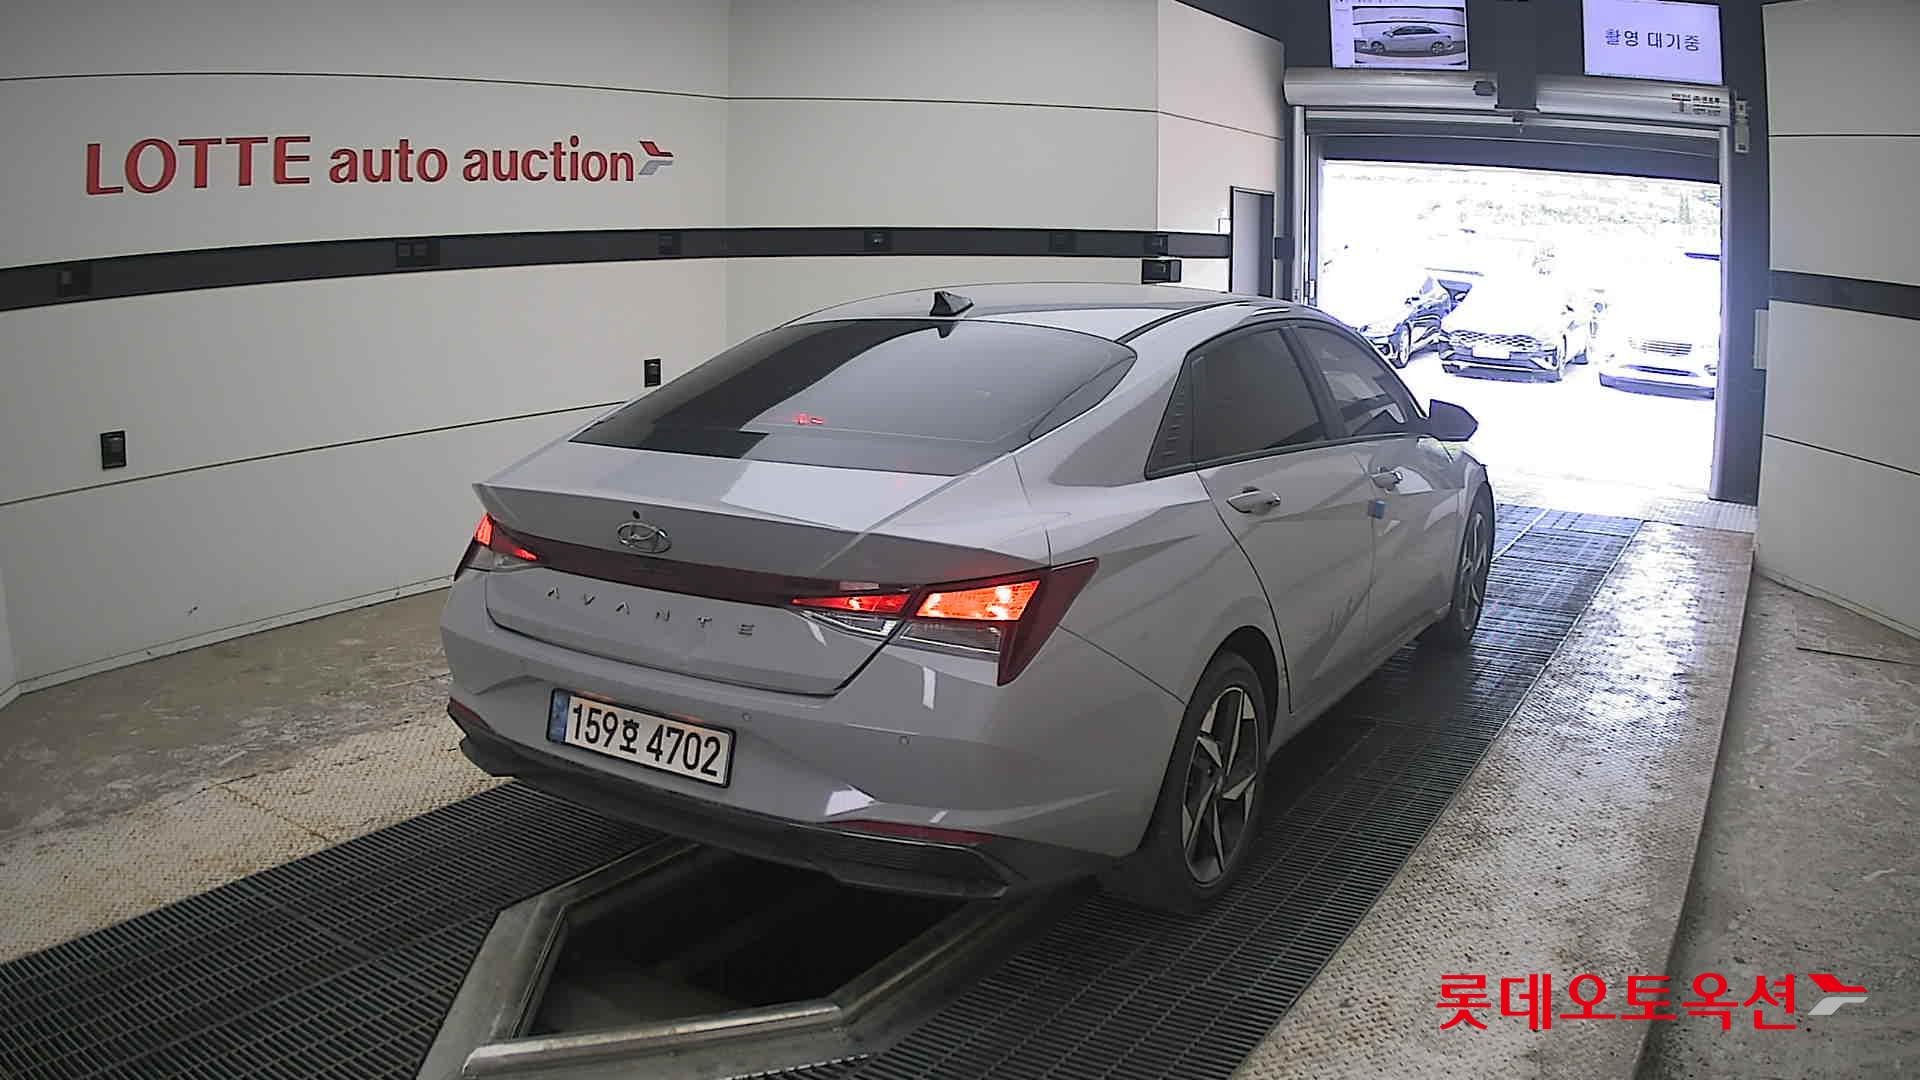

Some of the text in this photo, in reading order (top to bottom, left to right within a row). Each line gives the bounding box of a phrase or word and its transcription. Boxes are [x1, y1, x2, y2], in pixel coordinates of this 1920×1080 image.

[1647, 32, 1700, 52] 대기중
[86, 135, 635, 195] LOTTE auto auction
[547, 585, 756, 637] AVANTE
[572, 703, 721, 777] 159호 4702
